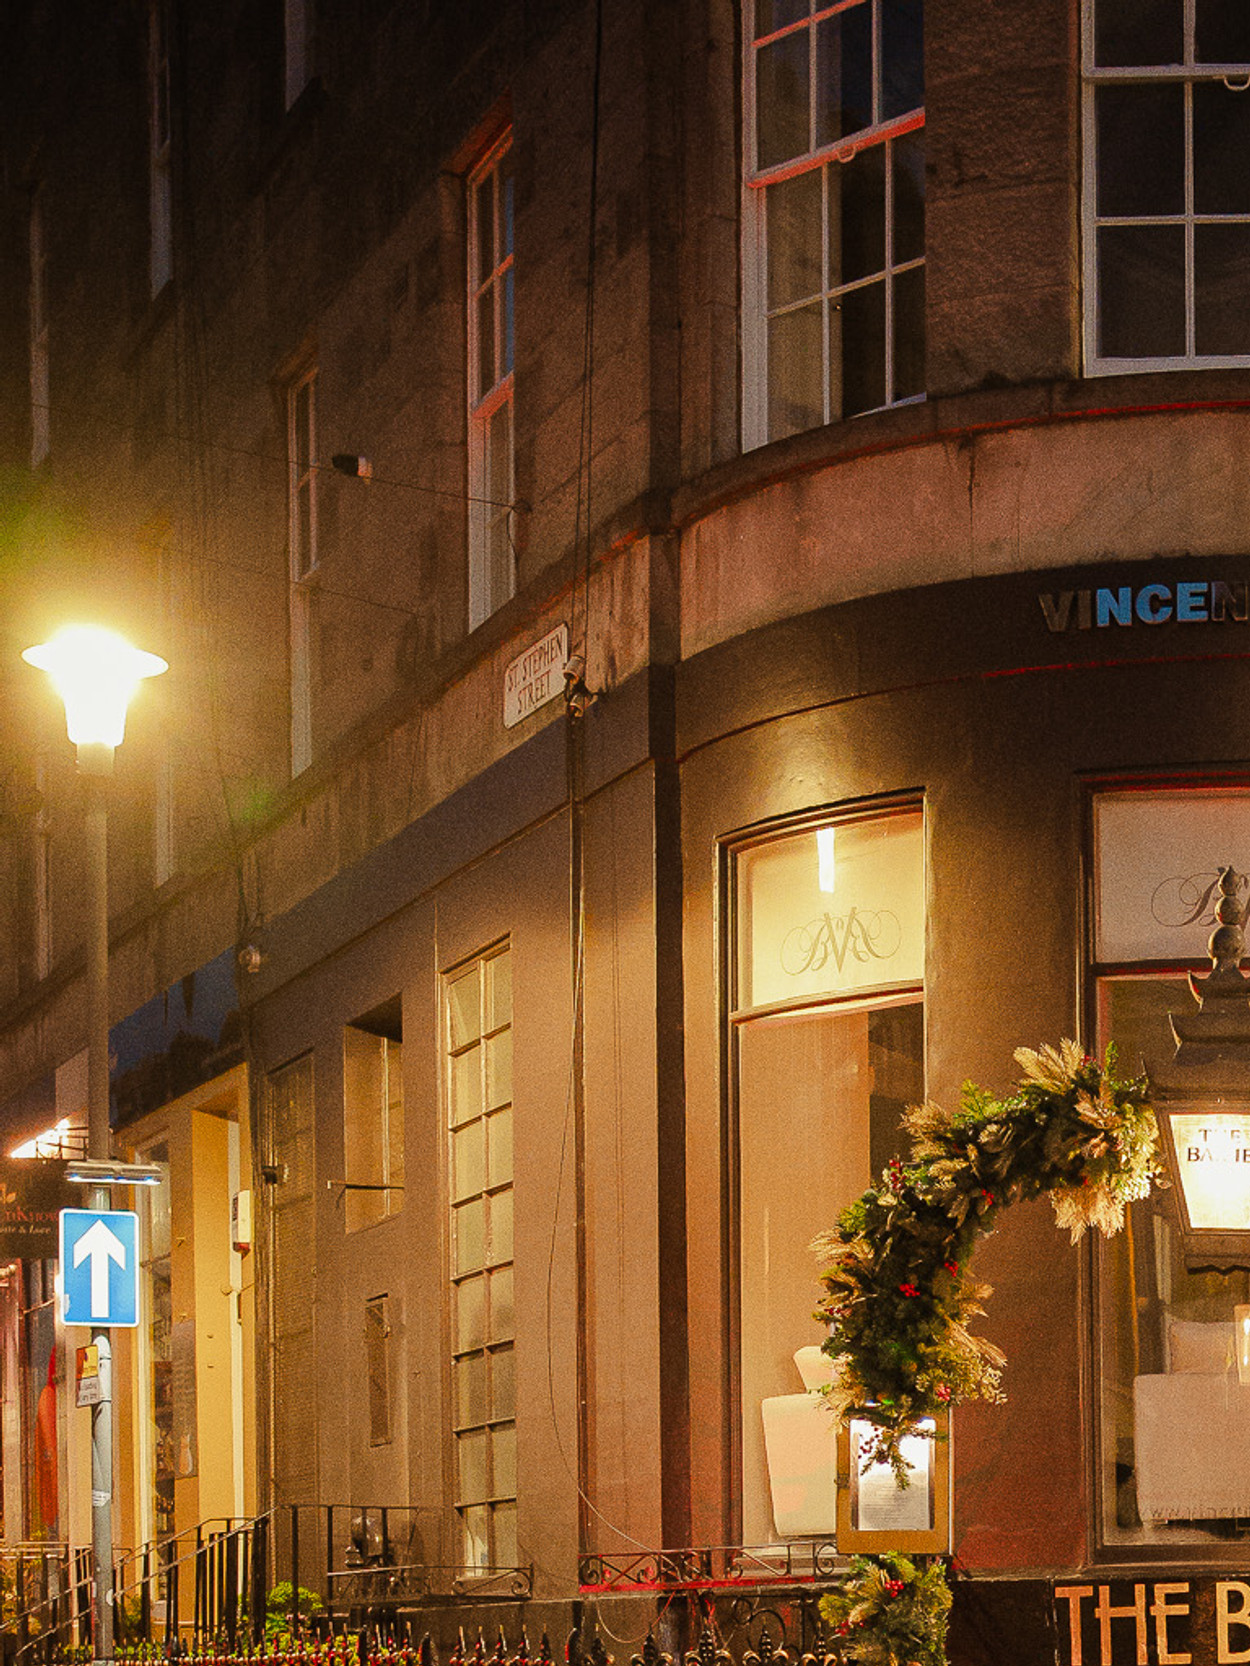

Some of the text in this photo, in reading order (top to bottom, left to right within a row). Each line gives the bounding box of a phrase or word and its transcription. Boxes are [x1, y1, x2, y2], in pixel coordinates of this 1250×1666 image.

[522, 631, 563, 681] STEPHEN
[517, 669, 551, 715] STREET
[1054, 1582, 1192, 1666] THE
